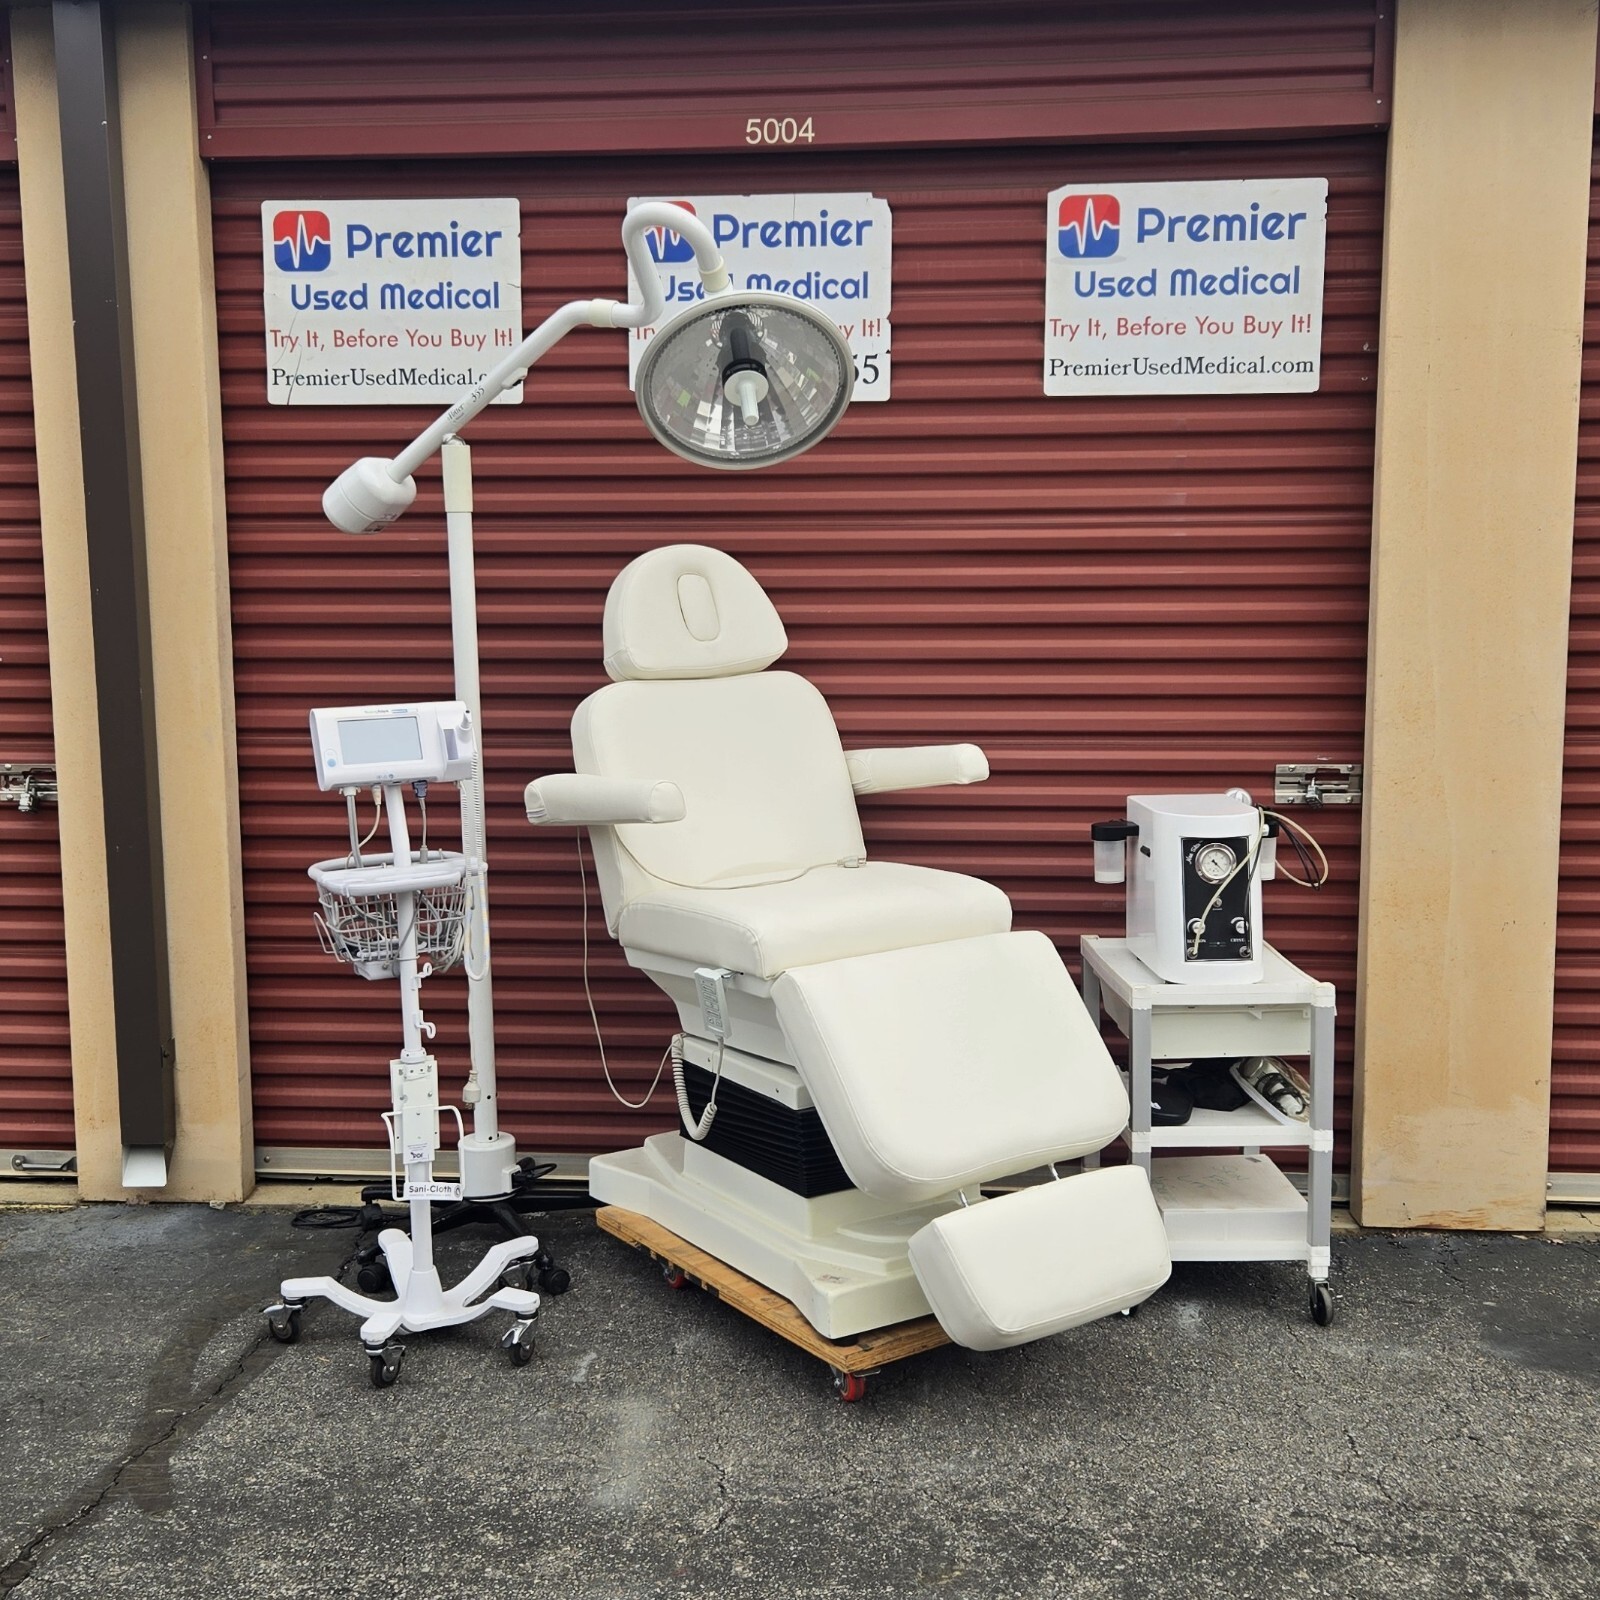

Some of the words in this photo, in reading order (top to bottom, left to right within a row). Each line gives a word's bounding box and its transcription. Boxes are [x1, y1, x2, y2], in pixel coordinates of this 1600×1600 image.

[745, 117, 815, 145] 5004
[713, 209, 873, 248] Premier
[1136, 202, 1308, 244] Premier
[346, 220, 503, 259] Premier
[291, 283, 369, 311] Used
[380, 281, 500, 310] Medical
[746, 271, 869, 300] Medical
[1074, 268, 1157, 298] Used
[1169, 265, 1301, 297] Medical
[269, 329, 299, 353] Try
[306, 330, 325, 351] It,
[333, 328, 399, 348] Before
[405, 328, 442, 348] You
[450, 328, 487, 352] Buy
[494, 328, 513, 347] It!
[862, 318, 881, 337] It!
[1049, 317, 1080, 342] Try
[1087, 317, 1107, 340] It,
[1116, 315, 1187, 337] Before
[1195, 315, 1234, 336] You
[1243, 314, 1283, 338] Buy
[1290, 313, 1312, 334] It!
[271, 367, 487, 386] PremierUsedMedical.c
[1049, 356, 1315, 377] PremierUsedMedical.com
[408, 1184, 452, 1193] Sani-Cloth
